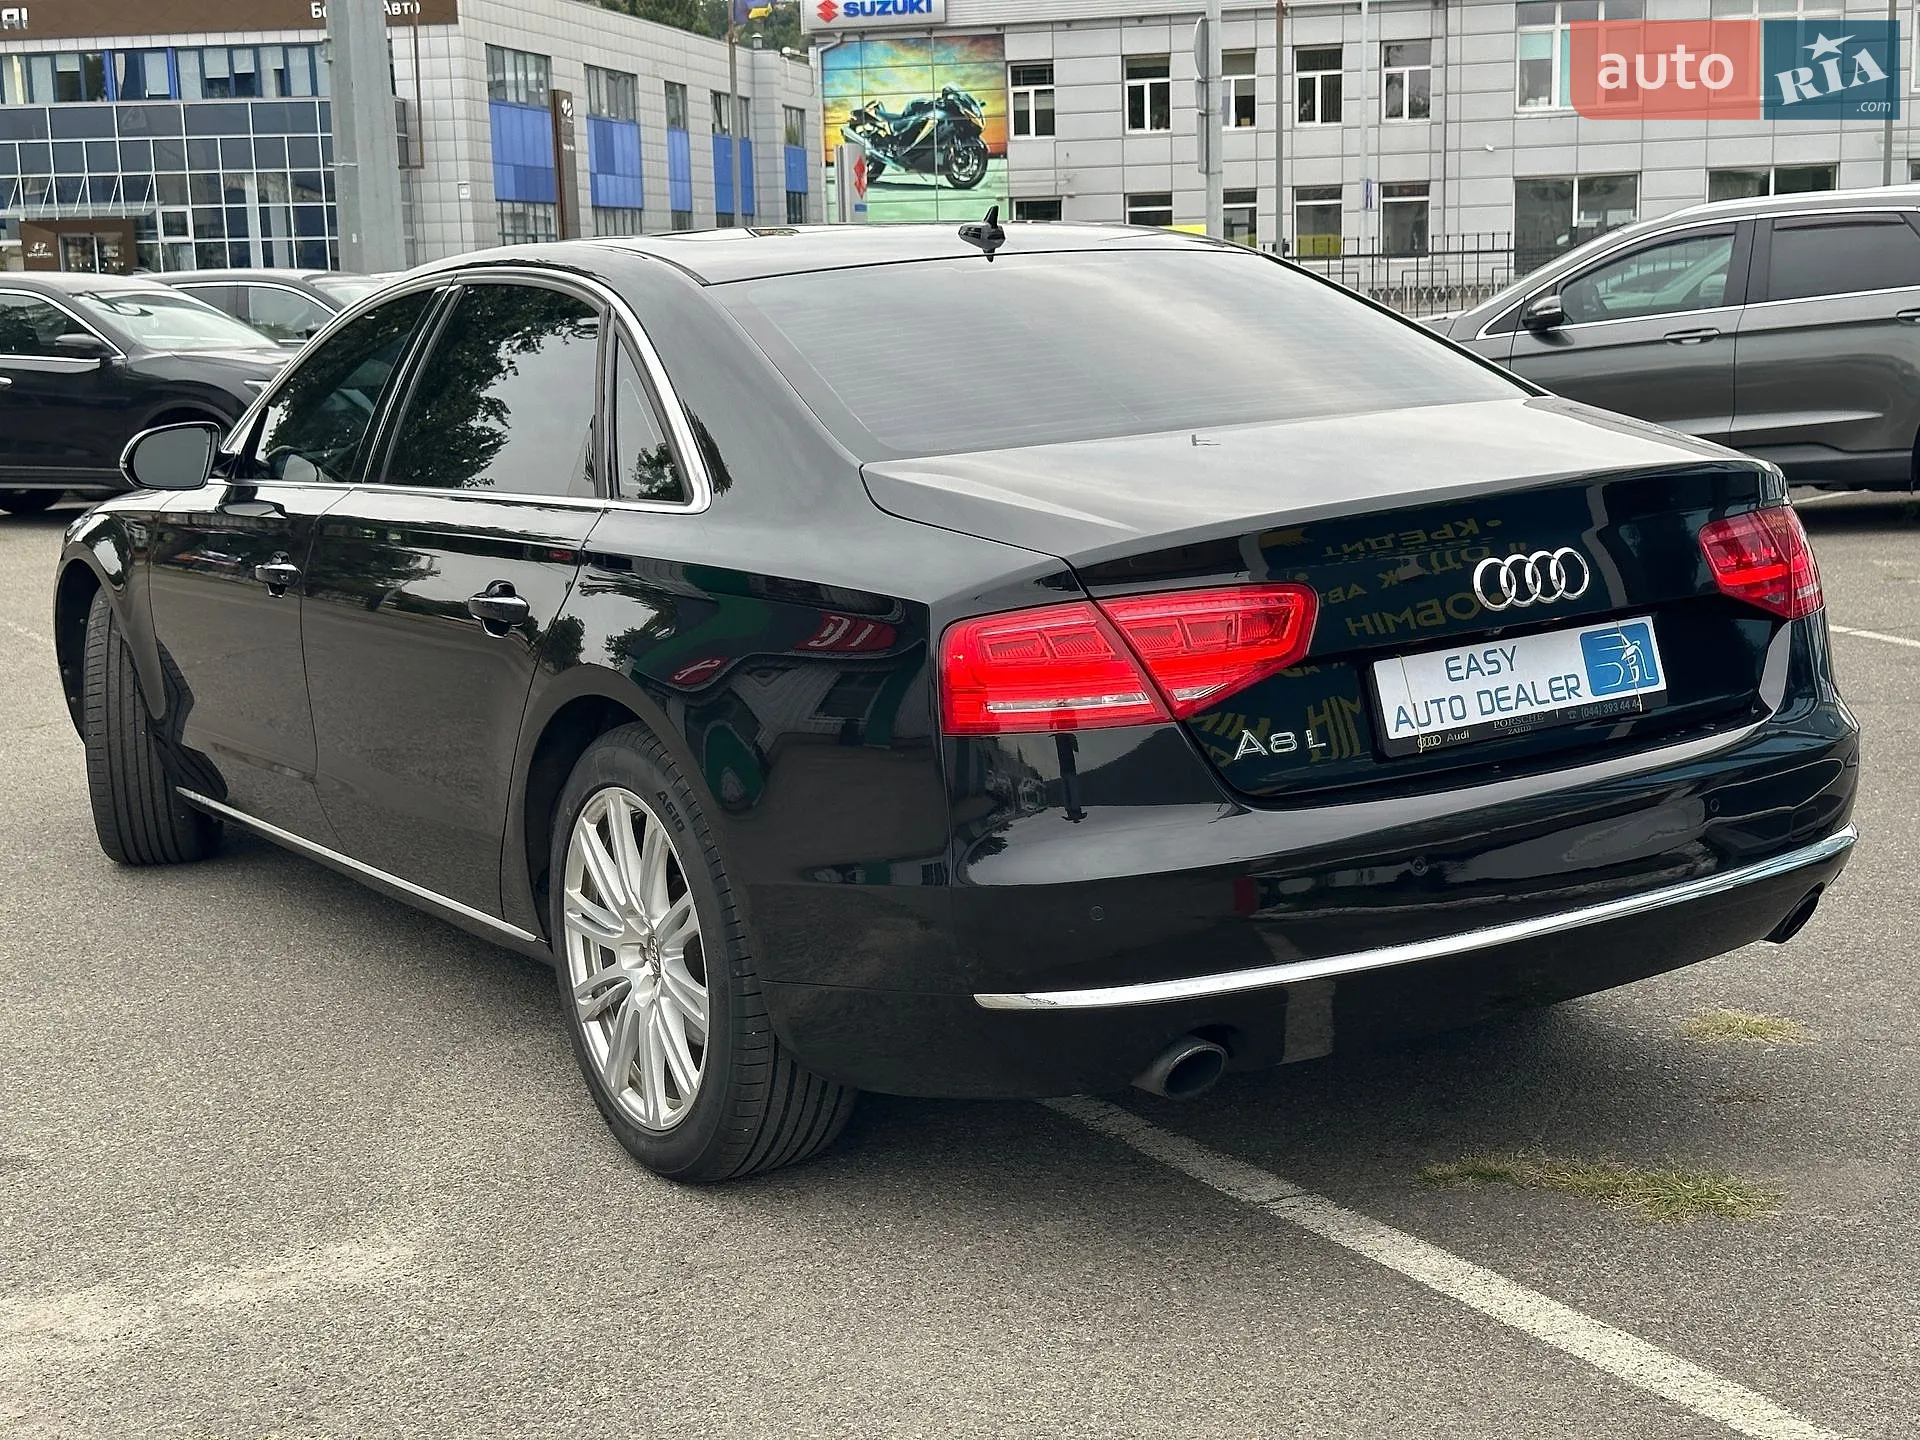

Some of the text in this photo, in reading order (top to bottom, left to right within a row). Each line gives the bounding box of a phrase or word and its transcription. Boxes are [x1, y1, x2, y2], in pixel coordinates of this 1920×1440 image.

[843, 0, 933, 18] SUZUKI
[1444, 645, 1518, 682] EASY
[1394, 694, 1467, 733] AUTO
[1476, 672, 1583, 716] DEALER
[1493, 712, 1545, 729] PORSCHE
[1233, 728, 1298, 761] A8
[1305, 729, 1327, 749] L
[1446, 729, 1470, 743] Audi
